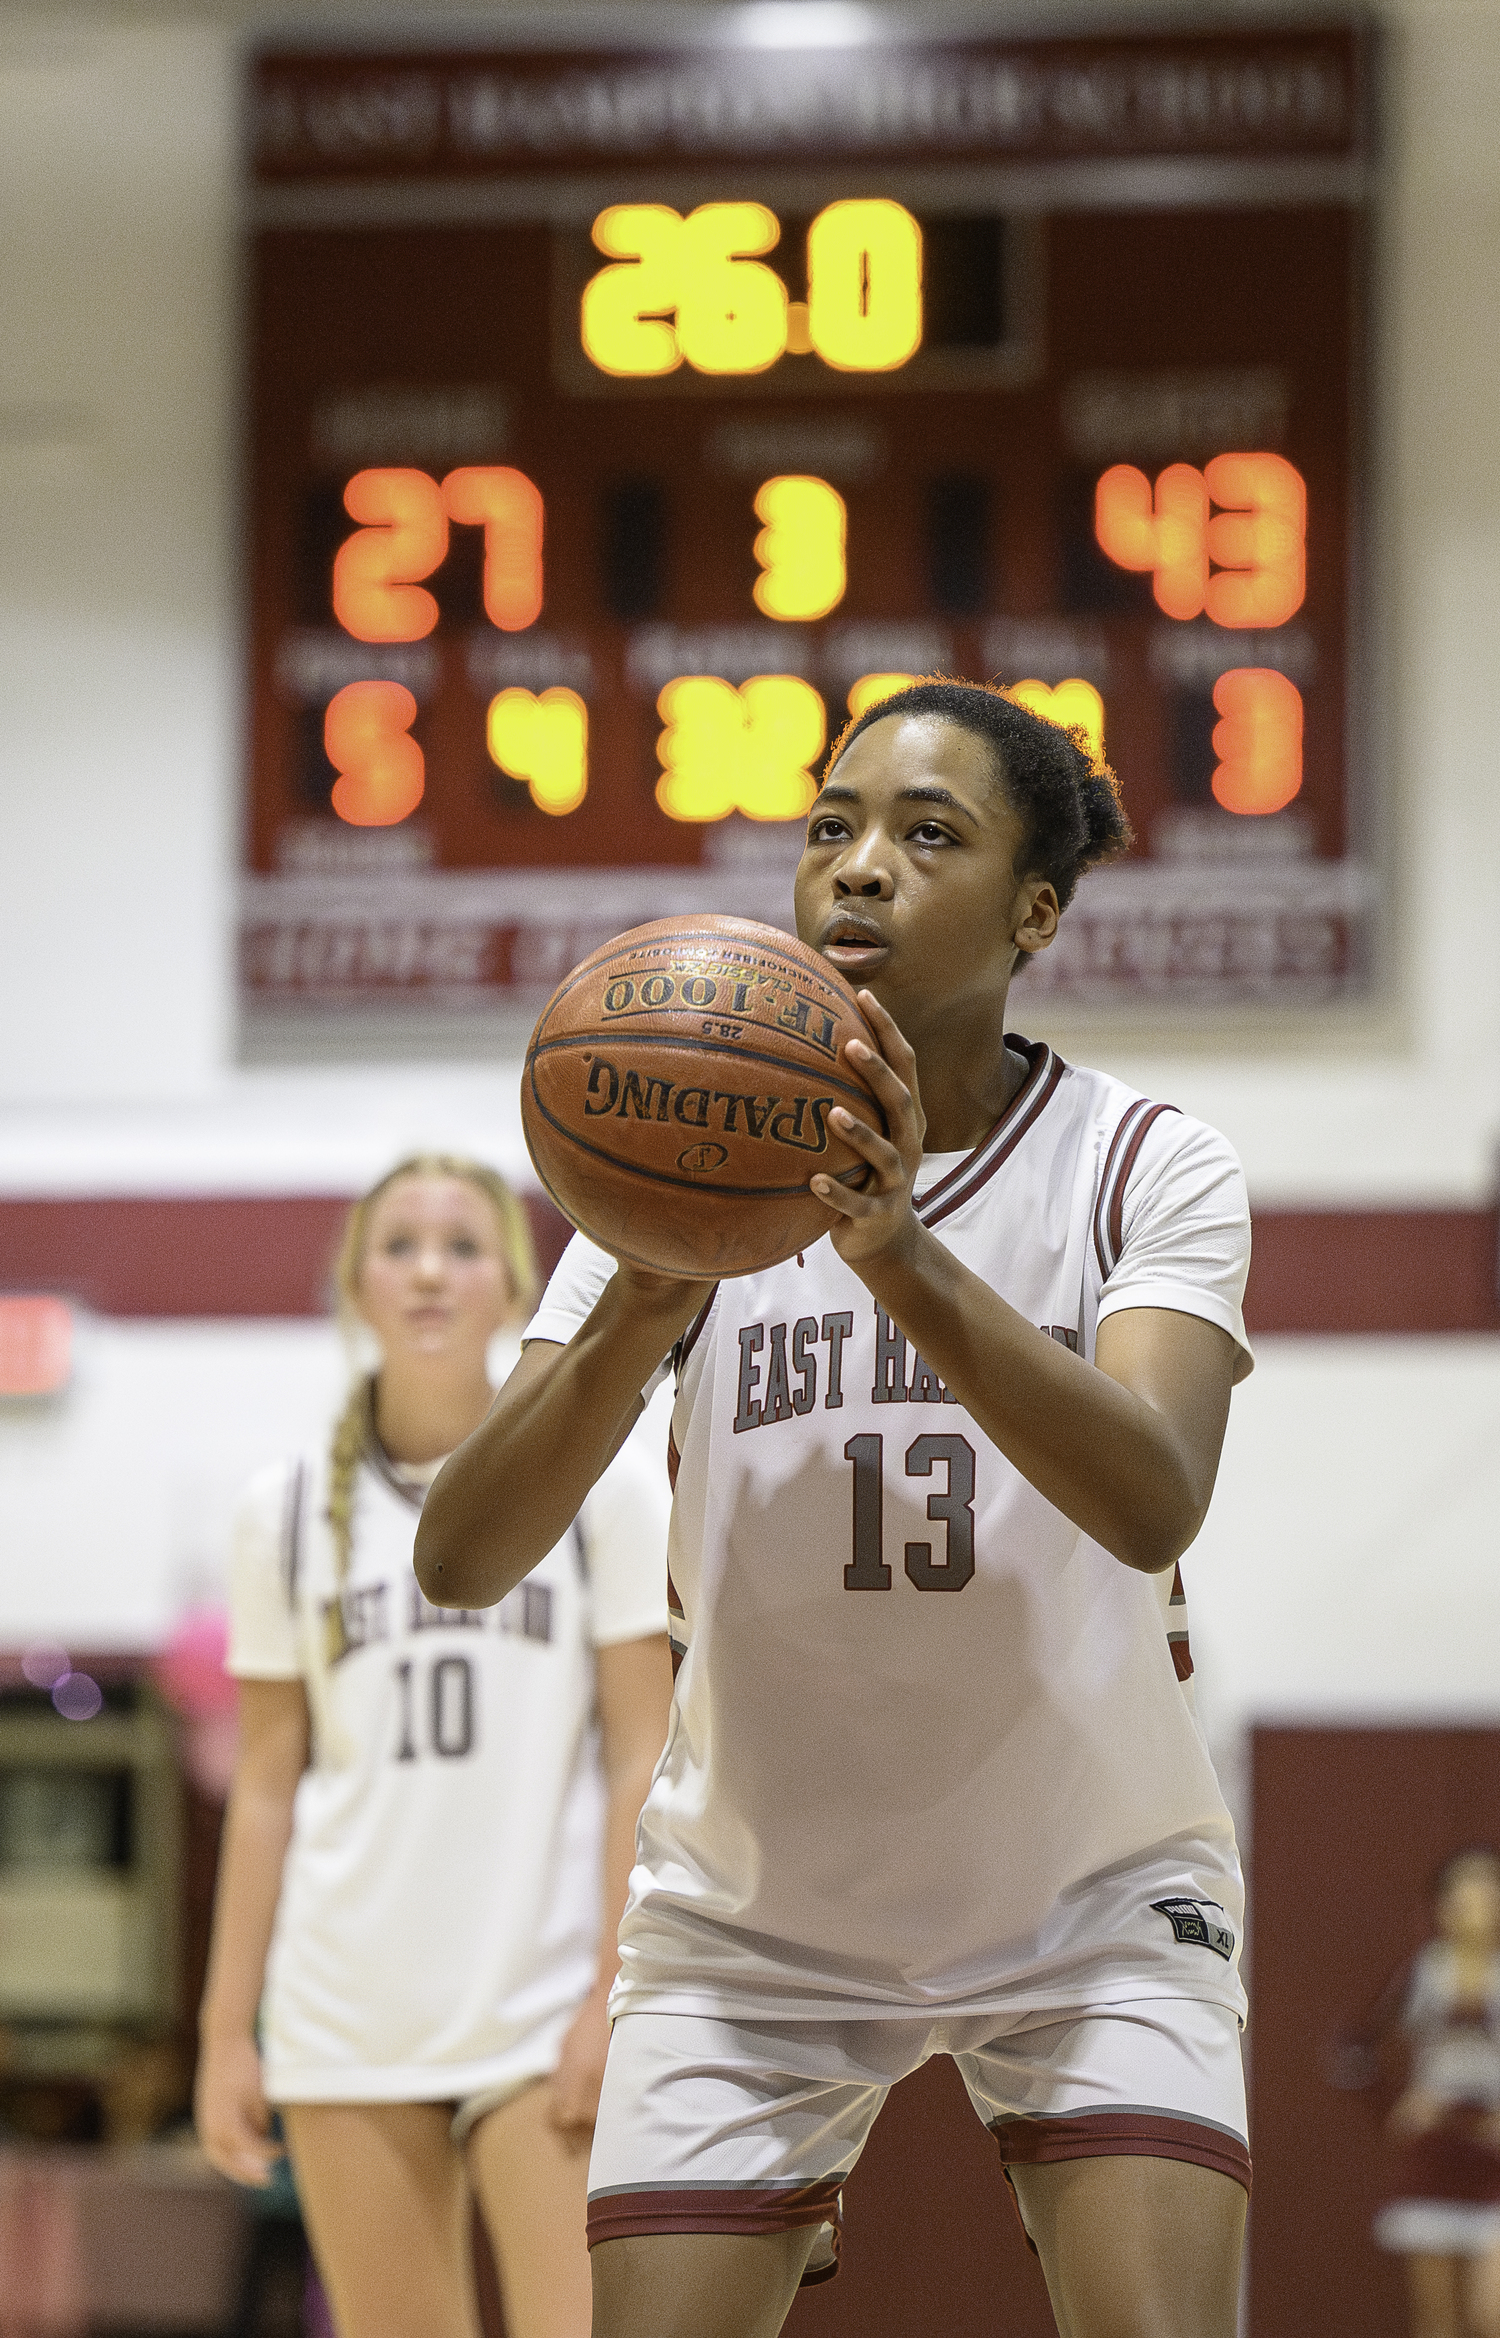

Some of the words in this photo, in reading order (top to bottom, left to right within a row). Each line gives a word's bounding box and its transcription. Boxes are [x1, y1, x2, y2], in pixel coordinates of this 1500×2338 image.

[581, 199, 923, 377] 26.0
[333, 467, 544, 643] 27
[752, 475, 847, 621] 3
[1095, 452, 1307, 630] 43
[324, 680, 425, 826] 5
[486, 686, 589, 817] 4
[1211, 667, 1304, 816] 3
[603, 974, 840, 1056] TF-1000
[701, 1020, 744, 1041] 28.5
[707, 961, 793, 993] CLASSIC
[583, 1055, 836, 1155] SPALDING
[733, 1311, 854, 1434] EAST
[843, 1433, 976, 1592] 13
[396, 1656, 477, 1762] 10
[1215, 1928, 1230, 1950] XL
